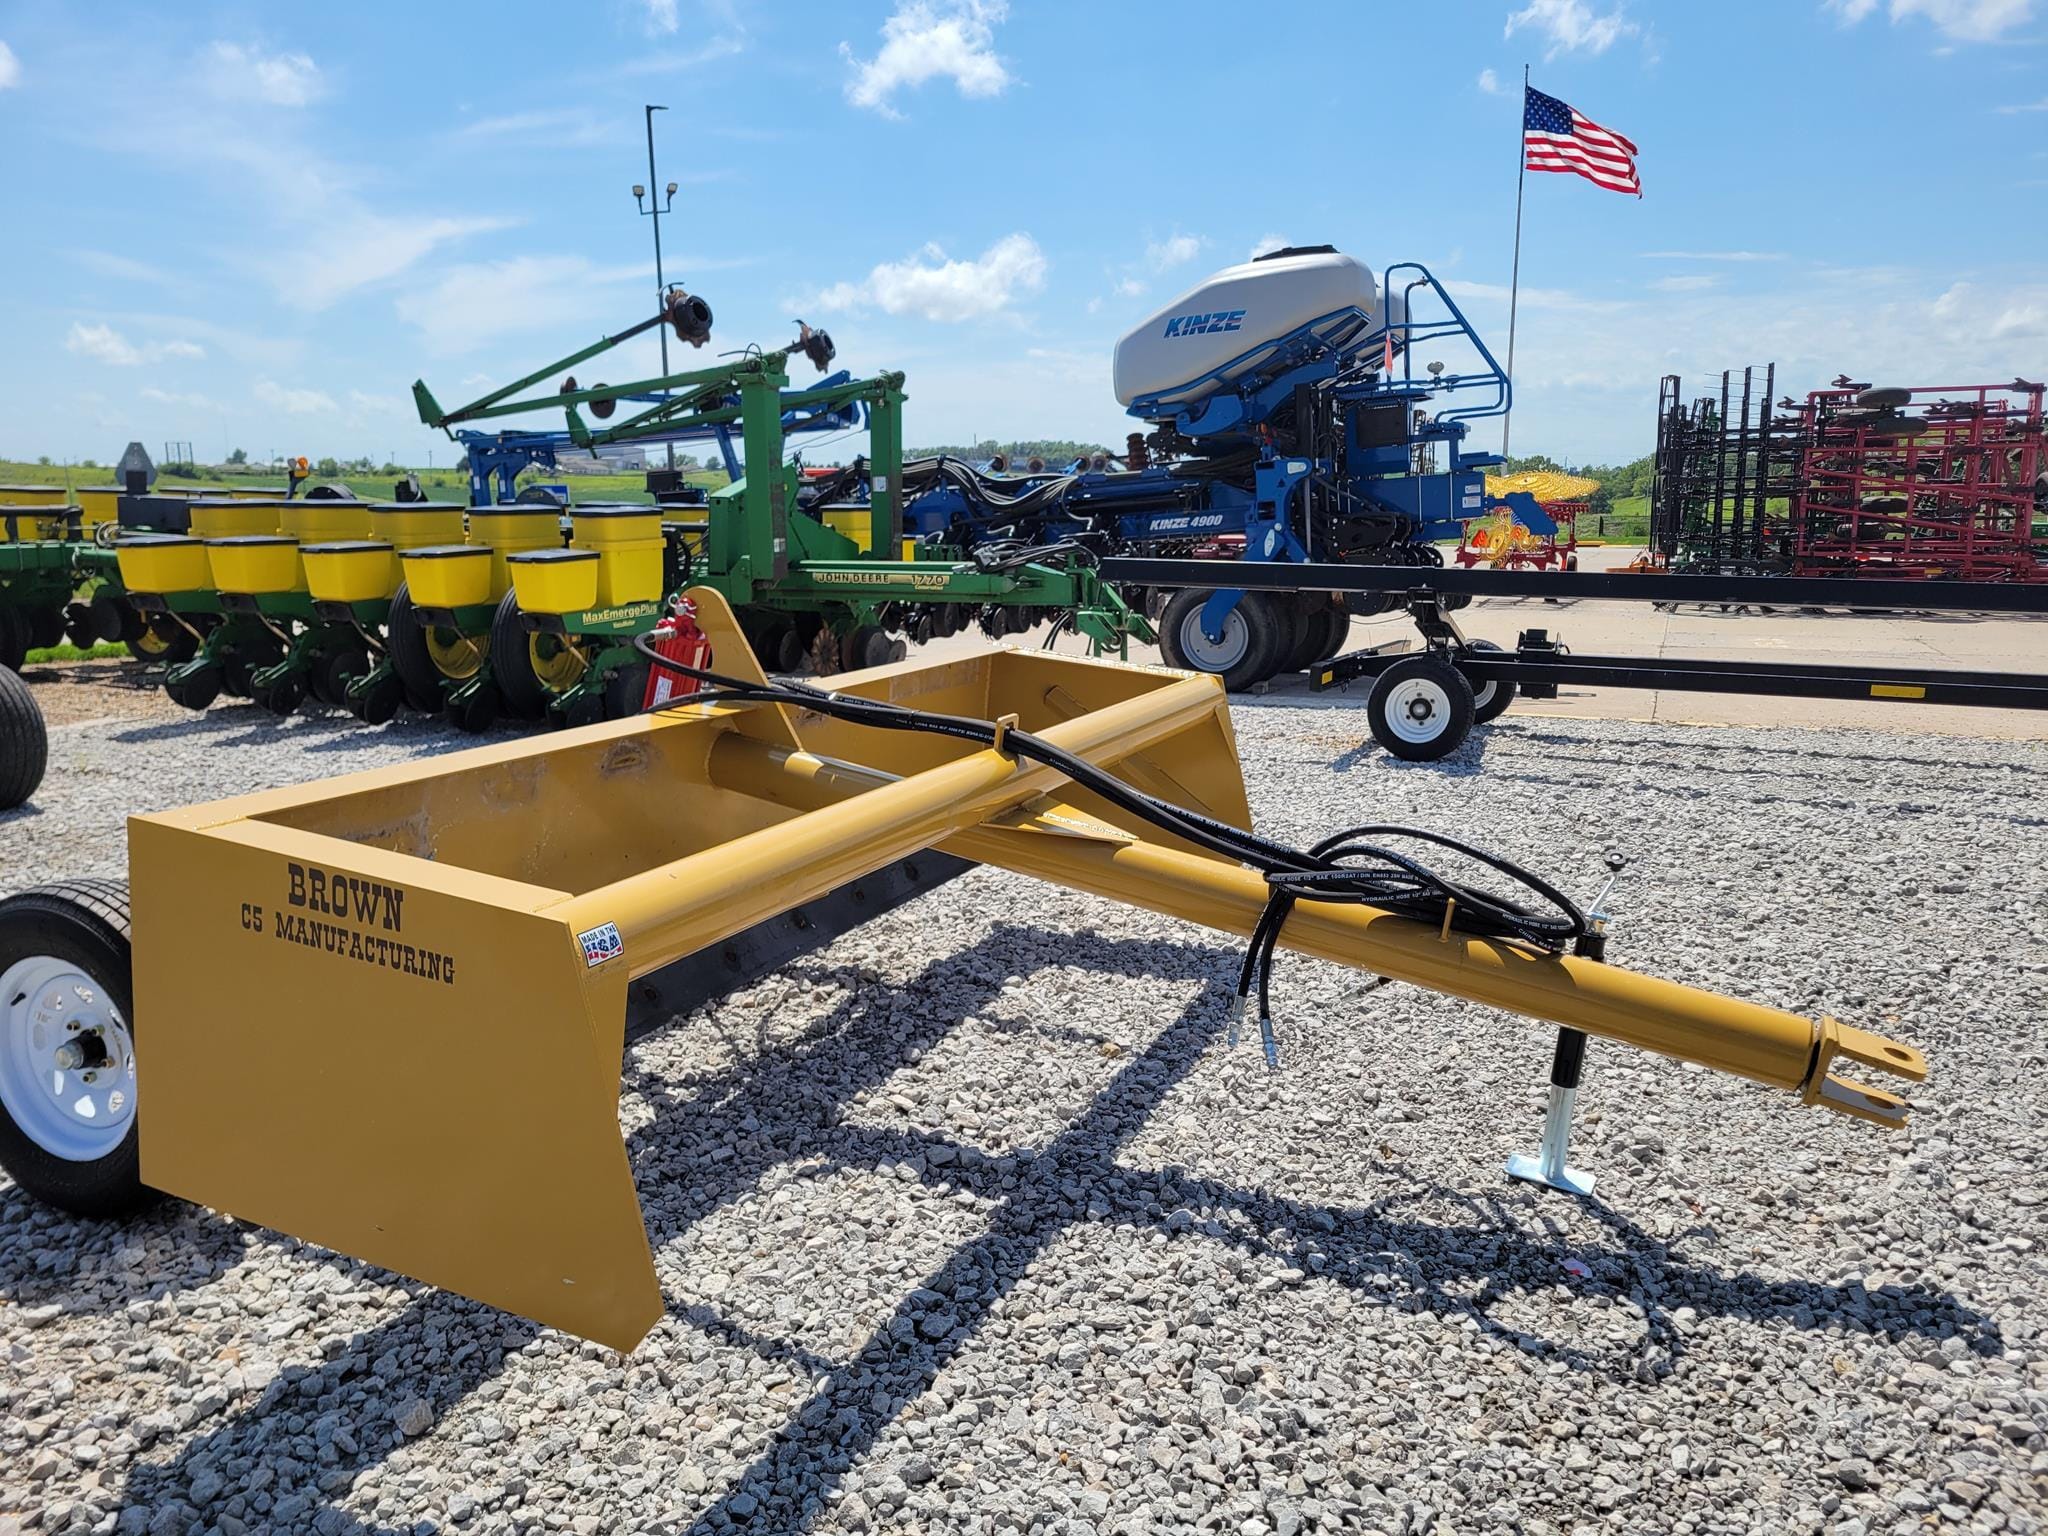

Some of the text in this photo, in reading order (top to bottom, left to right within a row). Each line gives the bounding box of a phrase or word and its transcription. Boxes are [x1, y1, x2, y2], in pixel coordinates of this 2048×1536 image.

[1163, 309, 1248, 338] KINZE
[1149, 514, 1223, 531] KINZE 4900
[818, 572, 944, 586] JOHN DEERE 1770
[288, 862, 404, 932] BROWN
[241, 903, 456, 985] C5 MANUFACTURING
[581, 931, 599, 944] MADE
